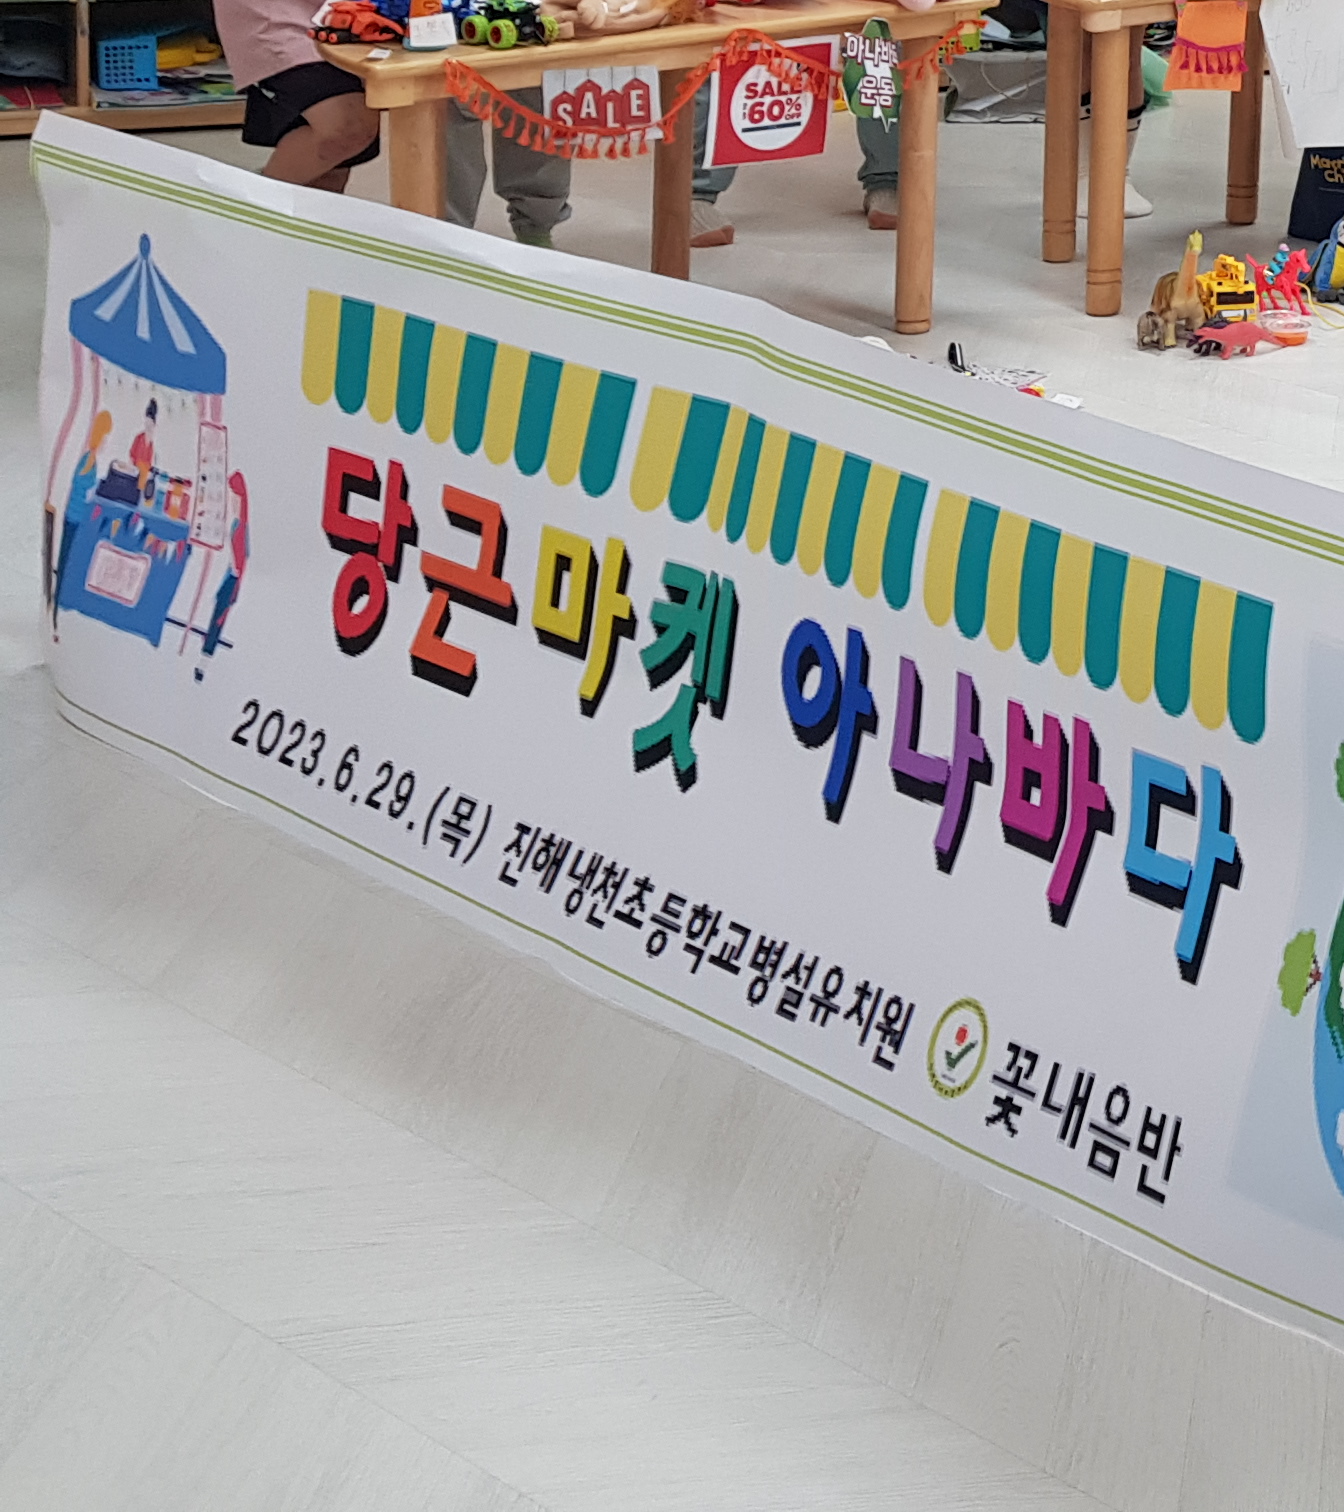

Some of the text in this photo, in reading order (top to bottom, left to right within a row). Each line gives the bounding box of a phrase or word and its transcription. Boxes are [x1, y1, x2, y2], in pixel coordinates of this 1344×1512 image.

[555, 88, 646, 128] SALE
[748, 96, 803, 125] 60%
[859, 74, 895, 108] 운동
[321, 446, 1243, 985] 당근마켓 아나바다
[231, 697, 494, 865] 2023.6.29.(목)
[498, 820, 917, 1072] 진해냉천초등학교병설유치원
[985, 1039, 1184, 1206] 꽃내음반
